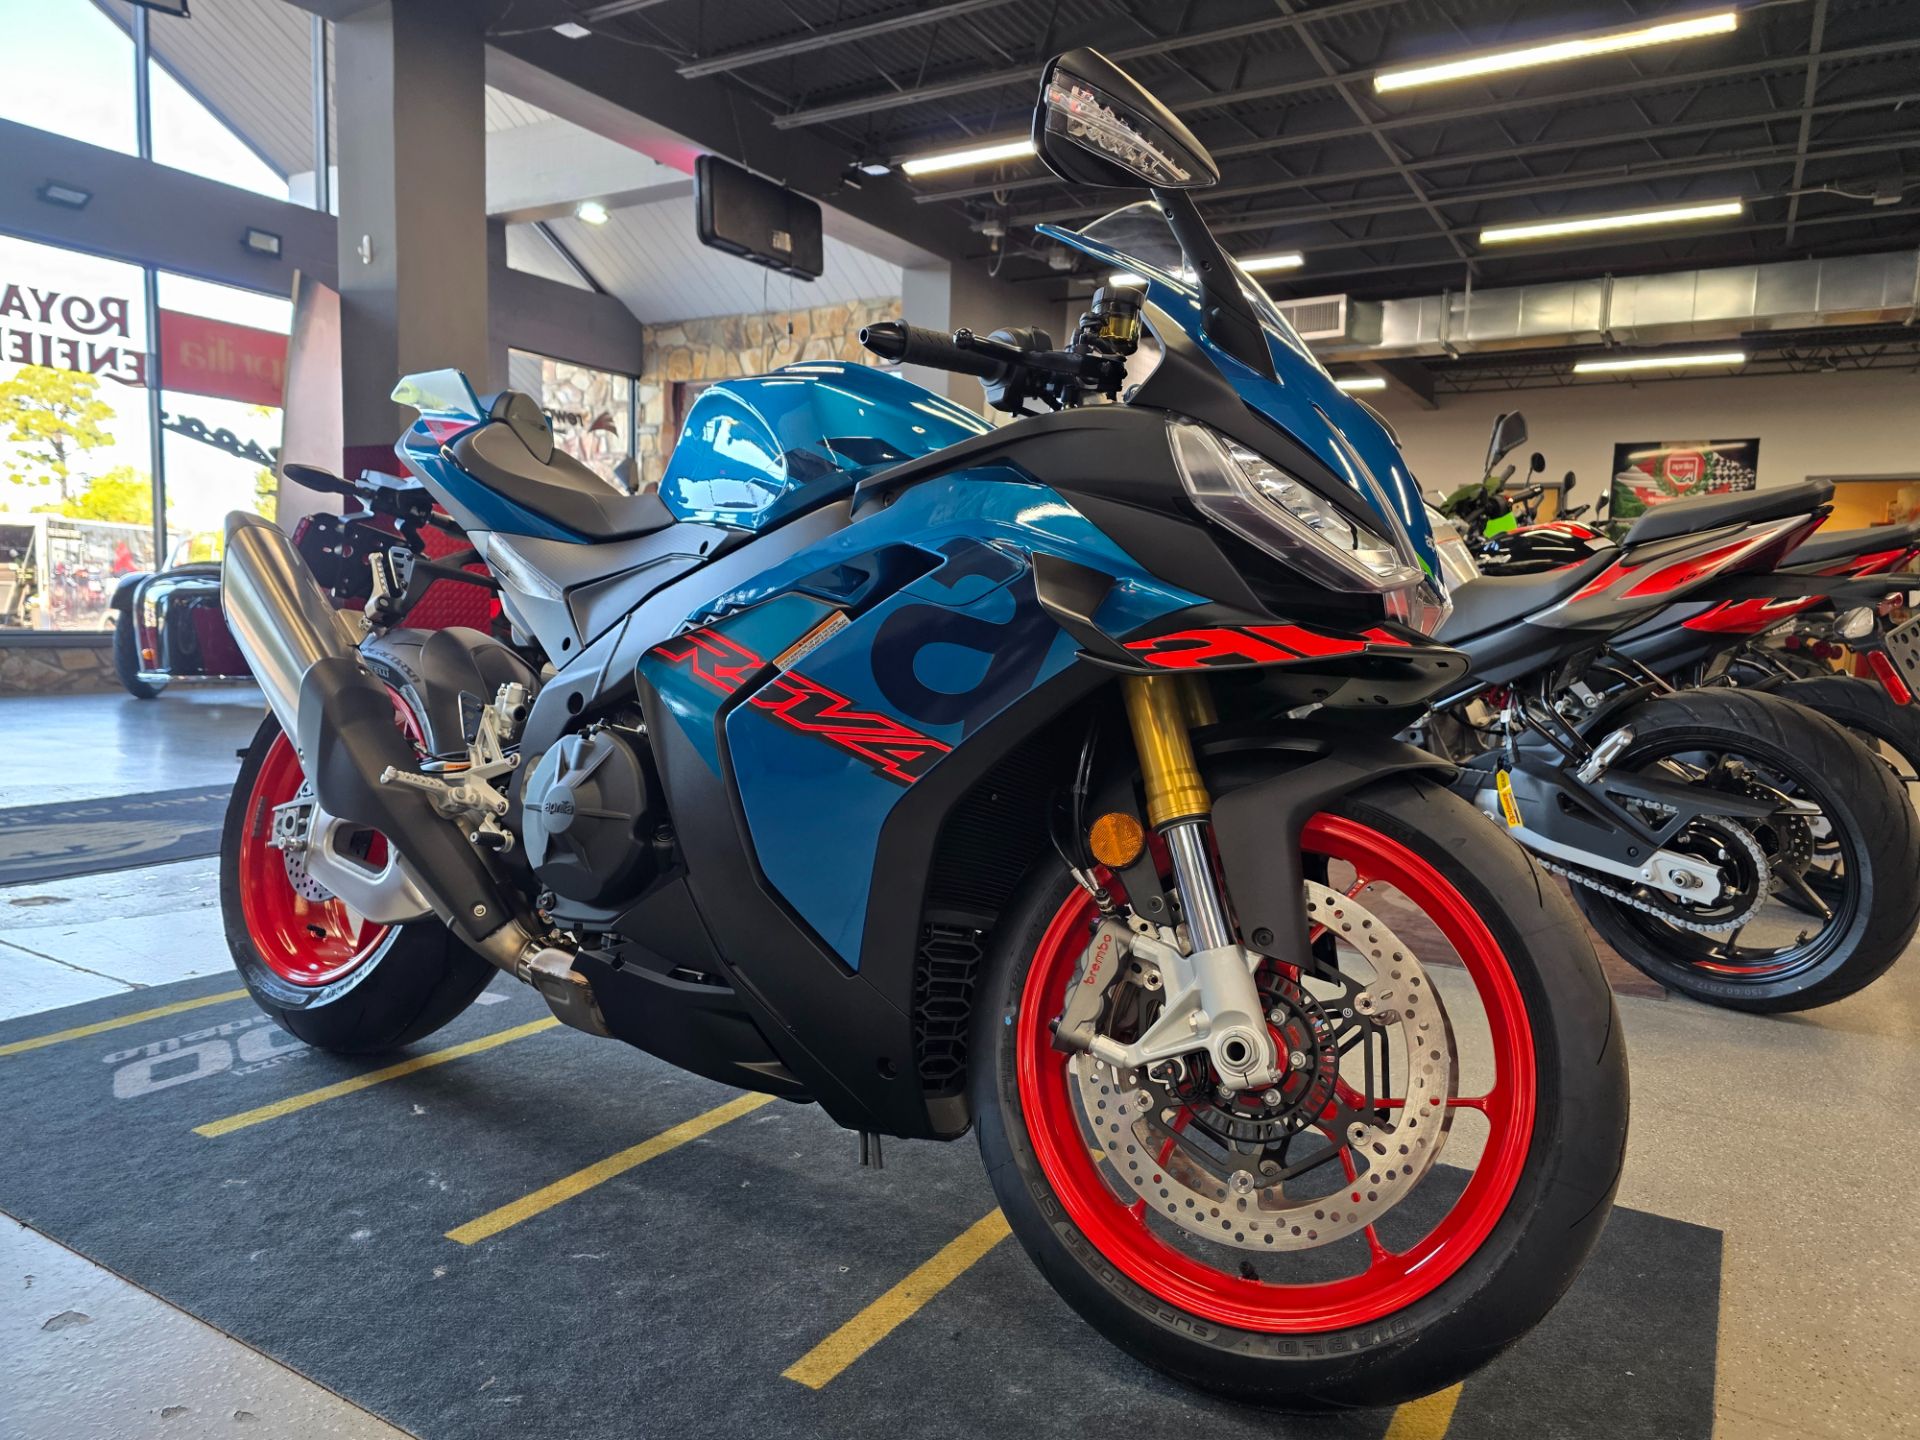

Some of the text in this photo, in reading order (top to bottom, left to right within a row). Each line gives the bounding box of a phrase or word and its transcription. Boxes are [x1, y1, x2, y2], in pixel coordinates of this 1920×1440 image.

[544, 800, 574, 815] aprilia
[1083, 934, 1112, 985] brembo
[102, 1014, 272, 1063] ndello
[1032, 1182, 1059, 1217] SP
[1063, 1228, 1210, 1338] SUPERCORSA
